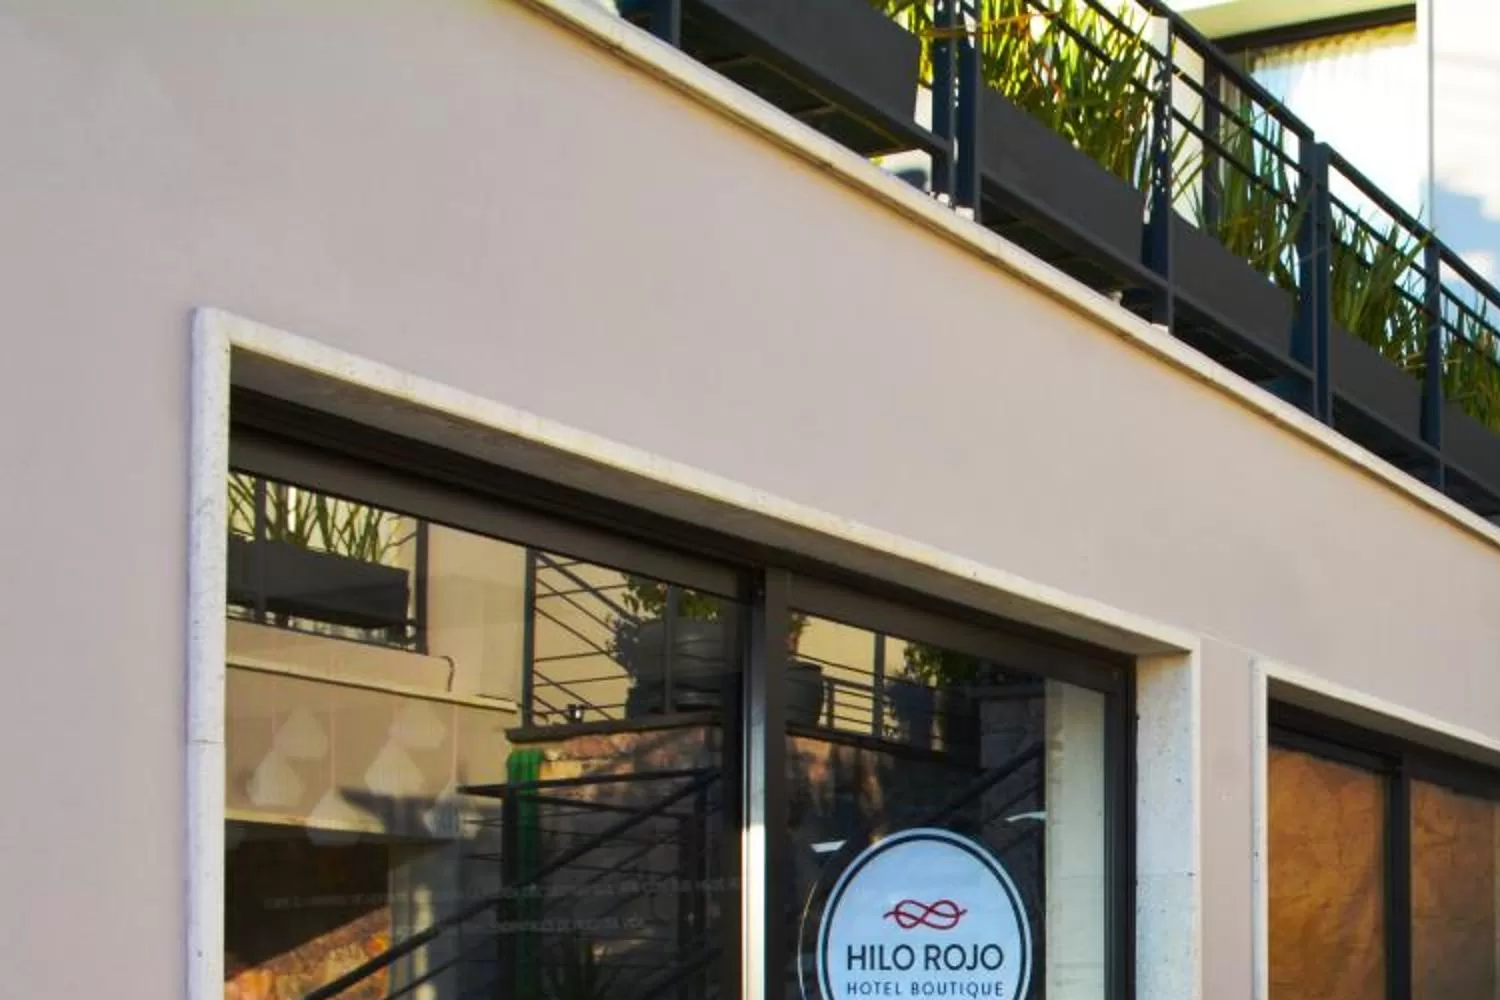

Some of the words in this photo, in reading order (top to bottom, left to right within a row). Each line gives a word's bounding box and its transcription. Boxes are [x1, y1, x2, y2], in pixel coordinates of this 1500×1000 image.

[847, 943, 915, 971] HILO
[924, 943, 1004, 971] ROJO
[847, 981, 902, 996] HOTEL
[911, 981, 1004, 999] BOUTIQUE
